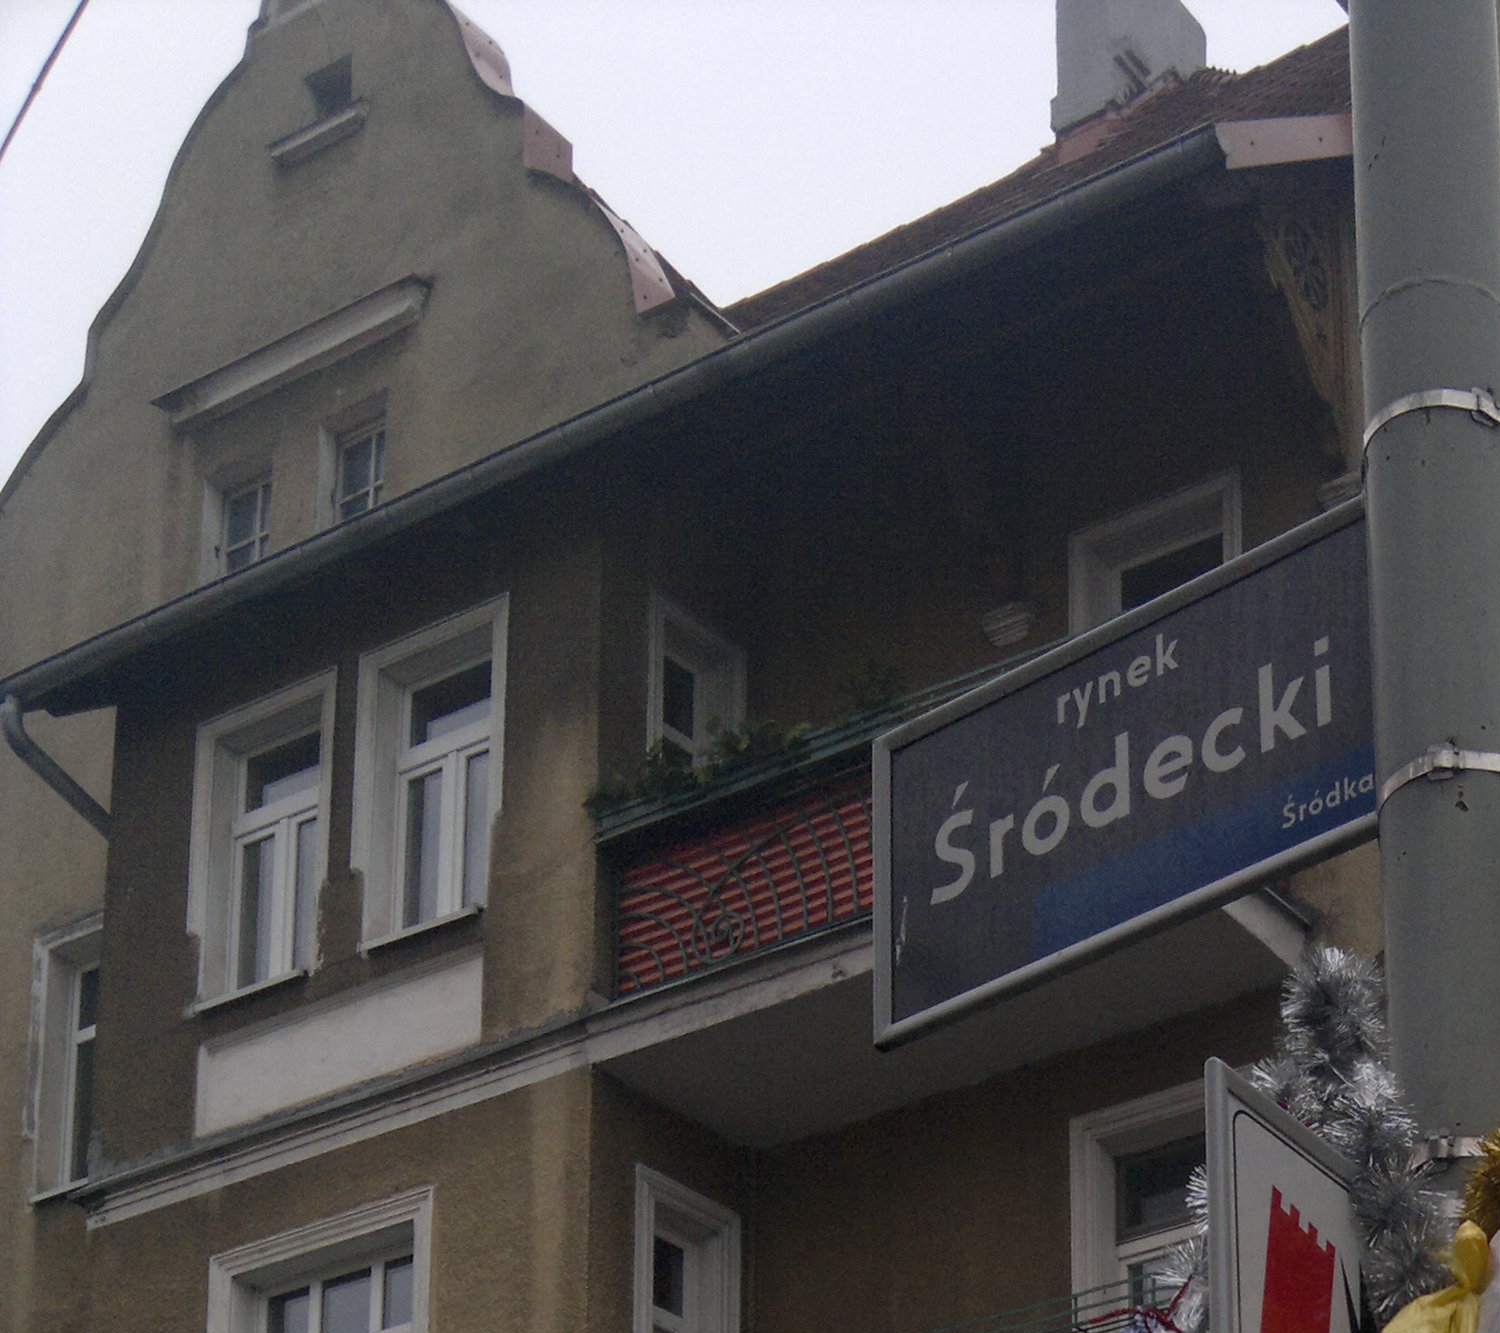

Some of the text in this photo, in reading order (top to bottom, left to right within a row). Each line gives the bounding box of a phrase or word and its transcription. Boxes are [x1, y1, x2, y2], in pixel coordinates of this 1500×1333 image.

[1057, 633, 1179, 729] rynek
[930, 636, 1331, 905] Śródecki
[1281, 773, 1375, 829] Śródka
